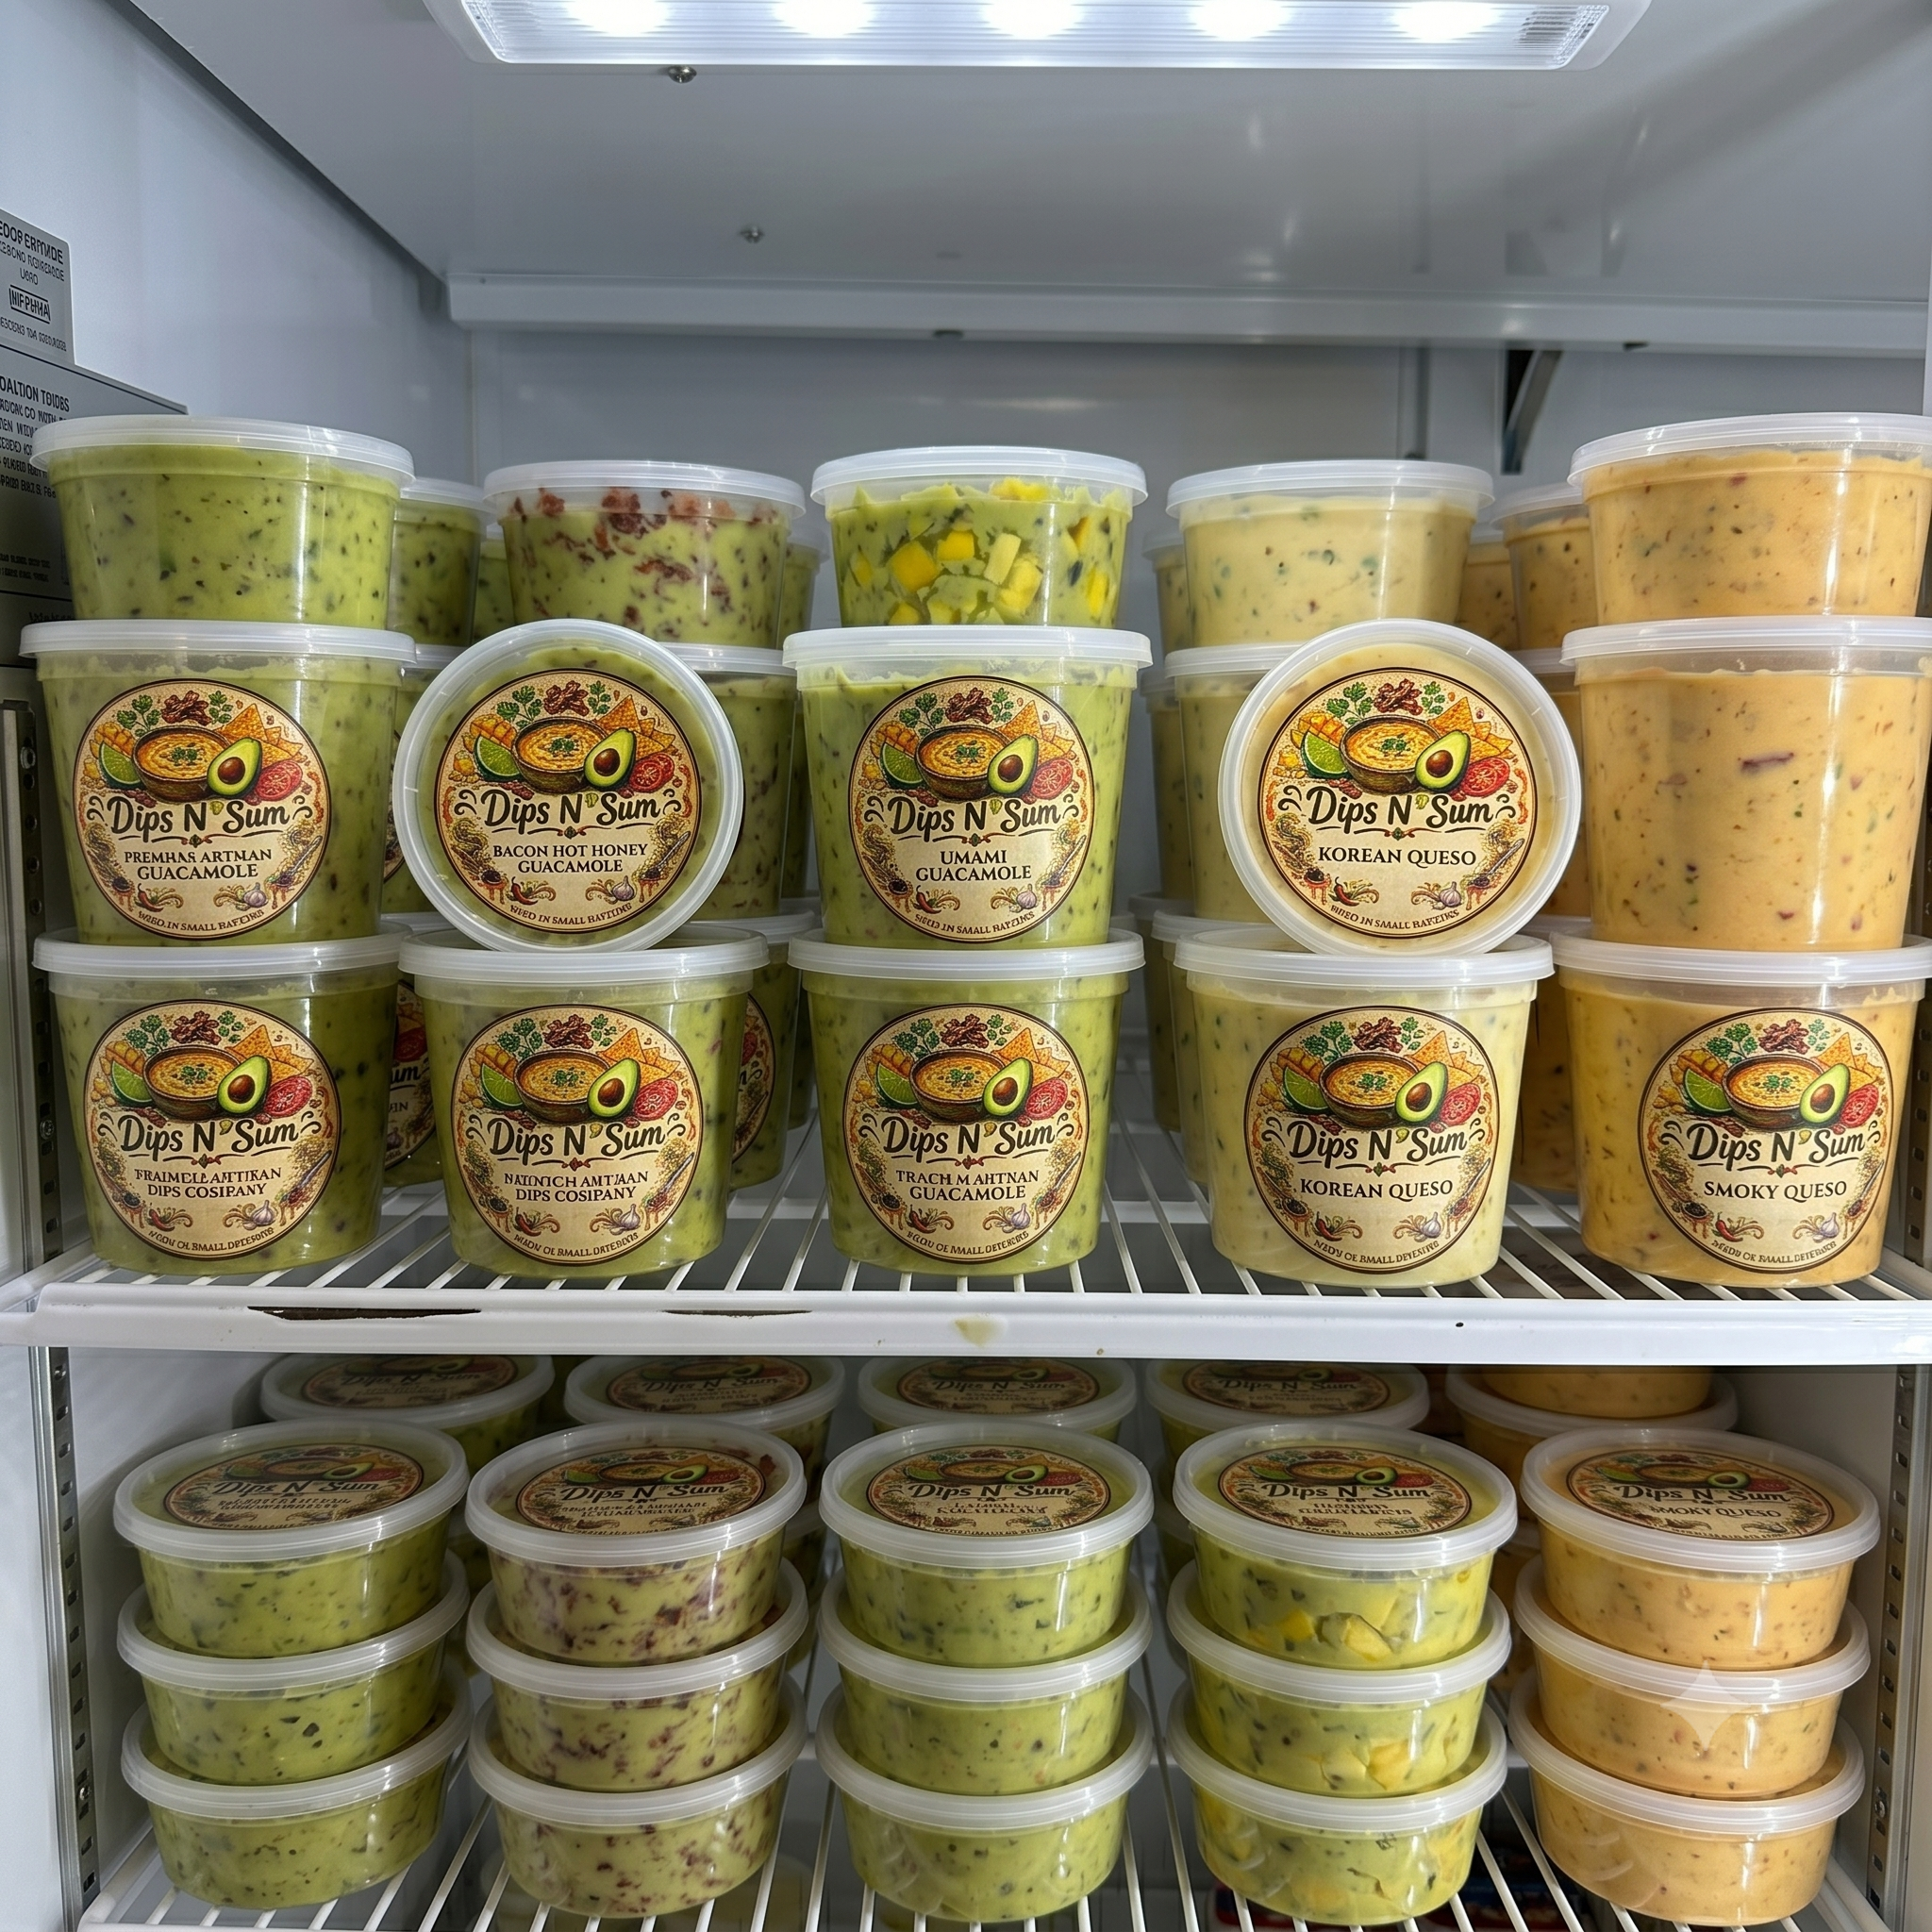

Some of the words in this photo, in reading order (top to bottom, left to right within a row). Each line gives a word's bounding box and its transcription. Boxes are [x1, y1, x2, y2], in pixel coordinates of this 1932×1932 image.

[108, 796, 174, 842] Dips
[223, 800, 291, 834] Sum
[481, 790, 550, 835] Dips
[596, 792, 660, 826] Sum
[887, 797, 956, 841] Dips
[1000, 799, 1061, 833] Sum
[1306, 787, 1377, 835] Dips
[1426, 794, 1493, 828] Sum
[493, 845, 548, 858] BACON
[554, 844, 589, 858] HOT
[591, 843, 648, 857] HONEY
[940, 850, 1008, 865] UMAMI
[1318, 846, 1401, 863] KOREAN
[1407, 850, 1476, 869] QUESO
[137, 863, 258, 880] GUACAMOLE
[518, 859, 623, 874] GUACAMOLE
[915, 865, 1031, 882] GUACAMOLE
[180, 923, 217, 931] SMALL
[552, 915, 586, 925] SMALL
[117, 1115, 183, 1161] Dips
[231, 1119, 299, 1153] Sum
[487, 1118, 554, 1165] Dips
[601, 1123, 665, 1157] Sum
[881, 1116, 947, 1163] Dips
[994, 1121, 1056, 1155] Sum
[1287, 1121, 1358, 1169] Dips
[1407, 1128, 1468, 1162] Sum
[1686, 1123, 1761, 1172] Dips
[1808, 1129, 1866, 1163] Sum
[148, 1184, 180, 1198] DIPS
[515, 1189, 550, 1203] DIPS
[909, 1185, 1025, 1201] GUACAMOLE
[1300, 1178, 1382, 1198] KOREAN
[1389, 1180, 1454, 1202] QUESO
[1704, 1181, 1778, 1200] SMOKY
[1784, 1180, 1847, 1203] QUESO
[212, 1481, 275, 1498] Dips
[318, 1480, 380, 1492] Sum
[561, 1484, 625, 1503] Dips
[668, 1483, 729, 1496] Sum
[908, 1484, 972, 1500] Dips
[1014, 1485, 1074, 1497] Sum
[1261, 1483, 1328, 1501] Dips
[1374, 1486, 1432, 1498] Sum
[1614, 1485, 1683, 1502] Dips
[1727, 1490, 1791, 1502] Sum
[1715, 1508, 1782, 1519] QUESO
